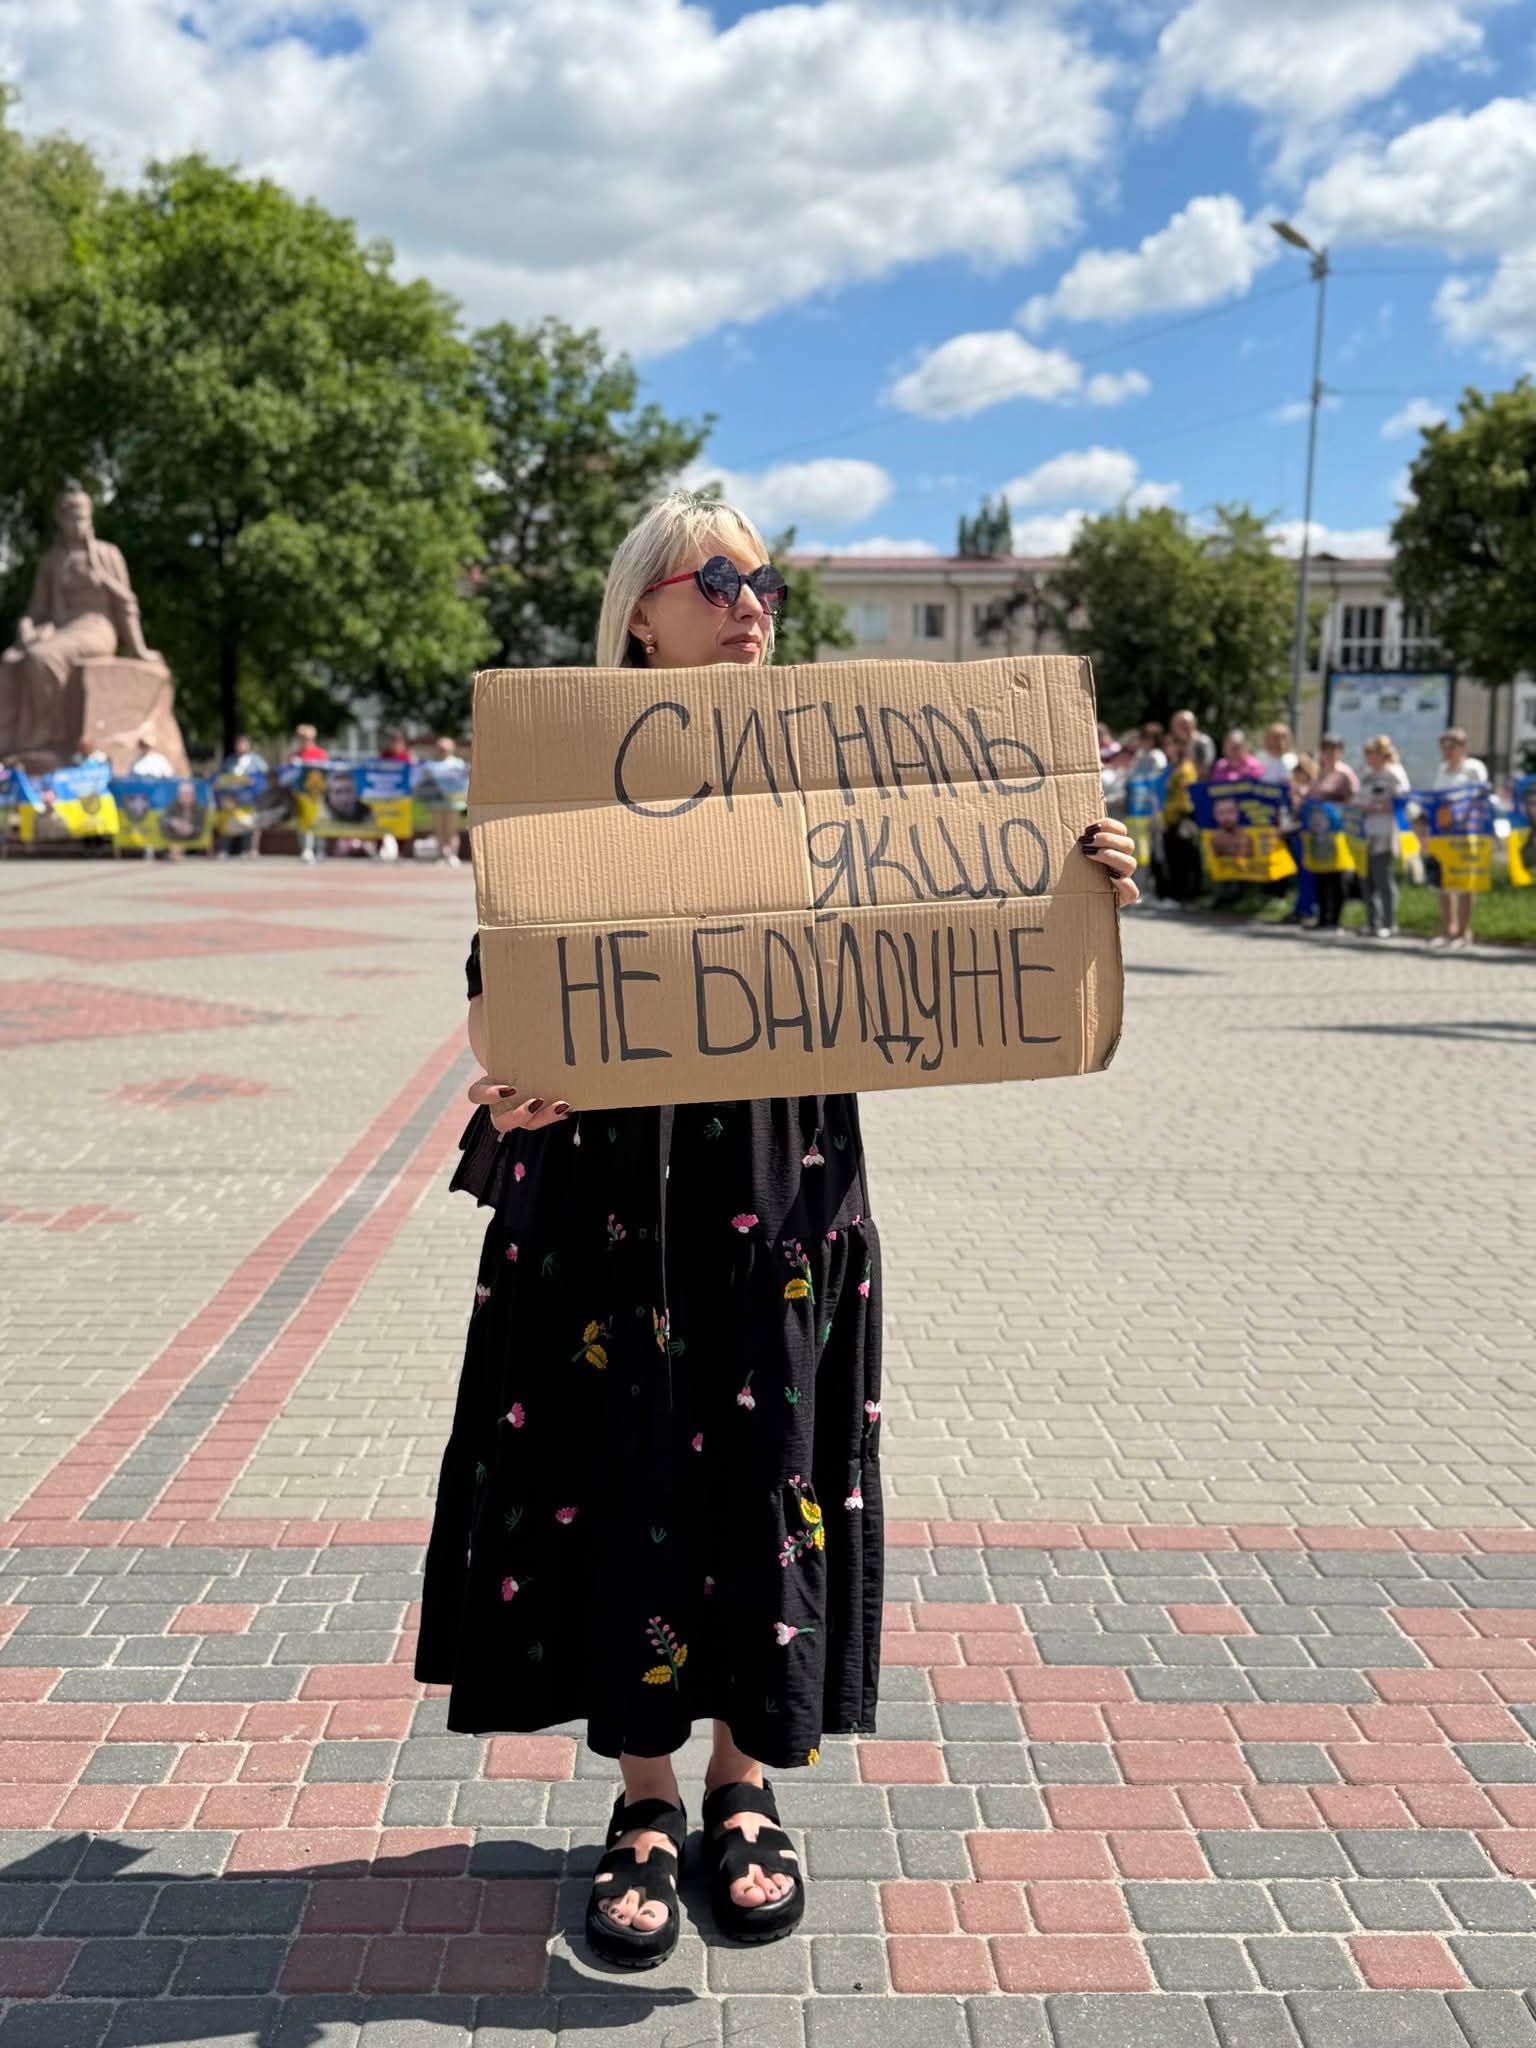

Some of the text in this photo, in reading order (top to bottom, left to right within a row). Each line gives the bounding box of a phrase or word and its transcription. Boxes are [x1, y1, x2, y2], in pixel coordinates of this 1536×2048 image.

[614, 701, 1047, 818] СИГНАЛЬ
[806, 816, 1052, 910] ЯКЩО
[556, 912, 1063, 1072] НЕ БАЙДУЖЕ
